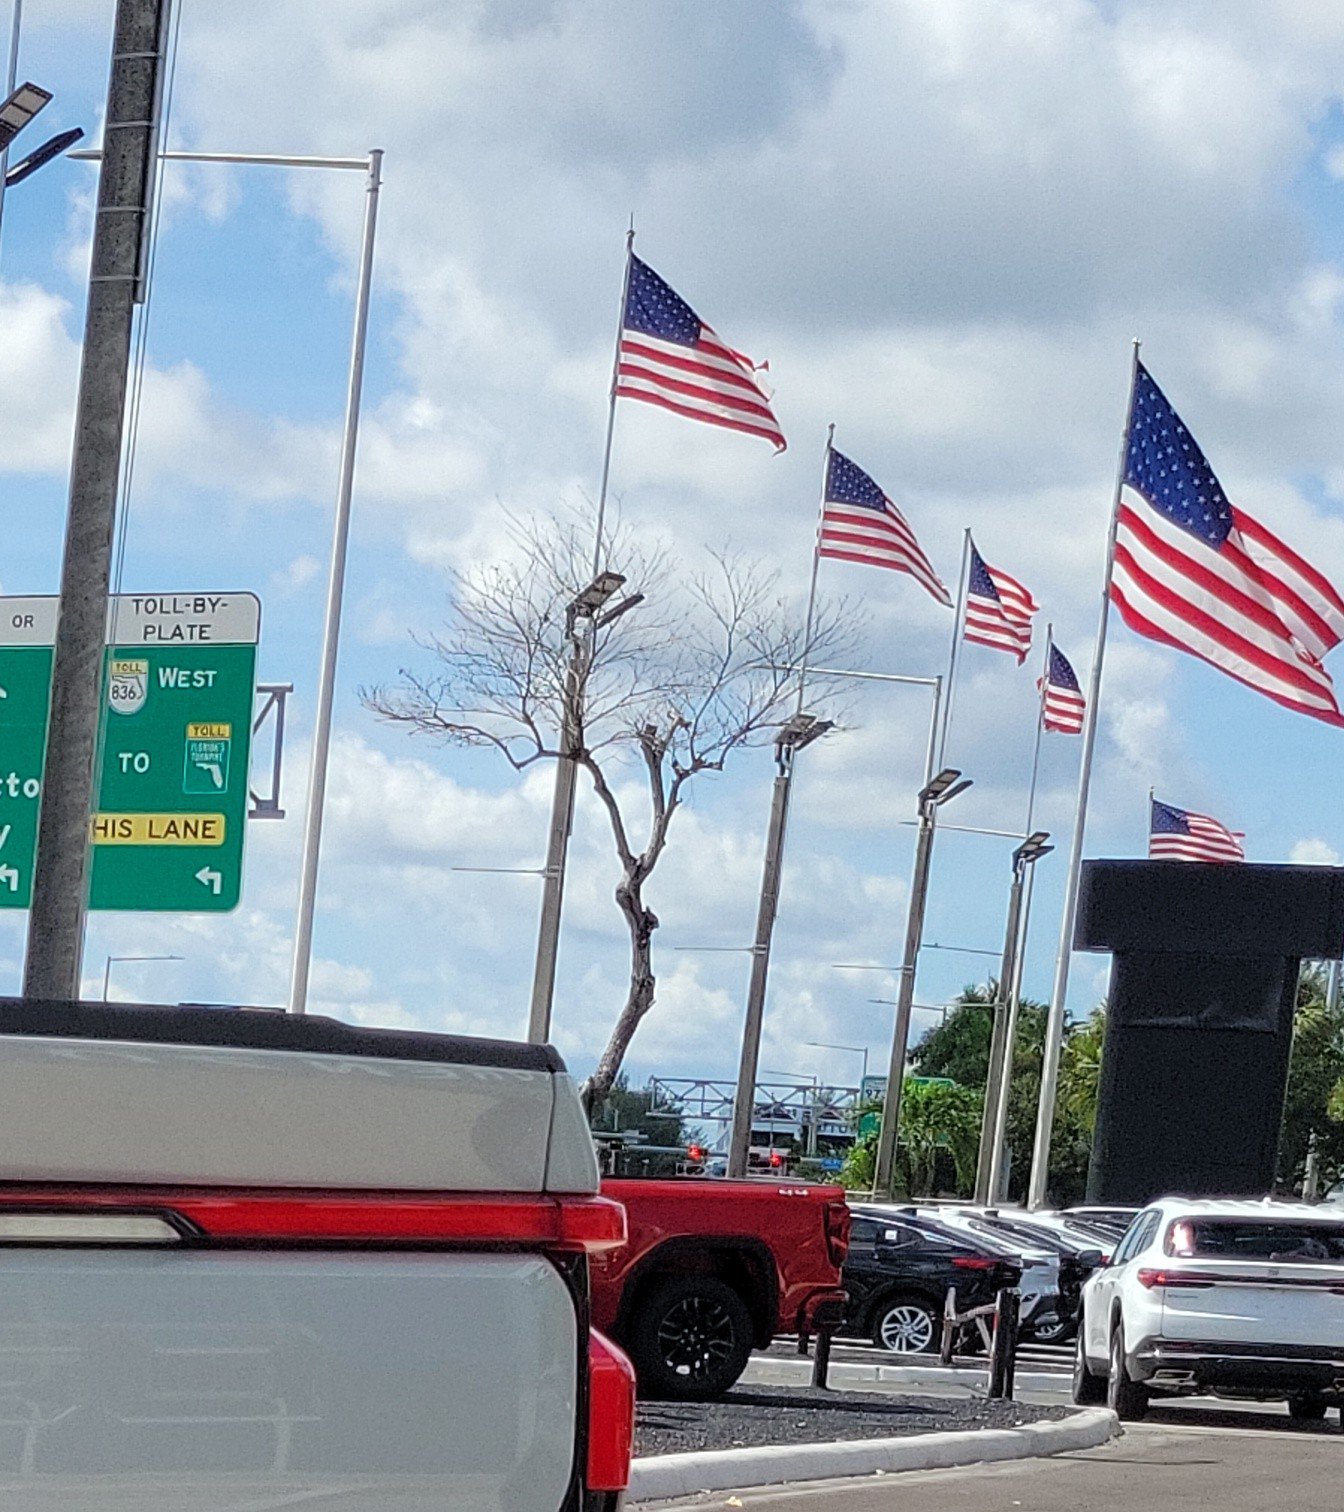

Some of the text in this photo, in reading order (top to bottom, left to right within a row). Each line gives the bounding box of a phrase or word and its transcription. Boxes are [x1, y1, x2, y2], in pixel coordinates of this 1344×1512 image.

[11, 615, 34, 629] OR
[142, 624, 212, 641] PLATE
[115, 662, 142, 672] TOLL
[158, 667, 218, 688] WEST
[111, 685, 136, 700] 836
[193, 726, 225, 737] TOLL
[118, 752, 150, 774] TO
[148, 819, 216, 840] LANE
